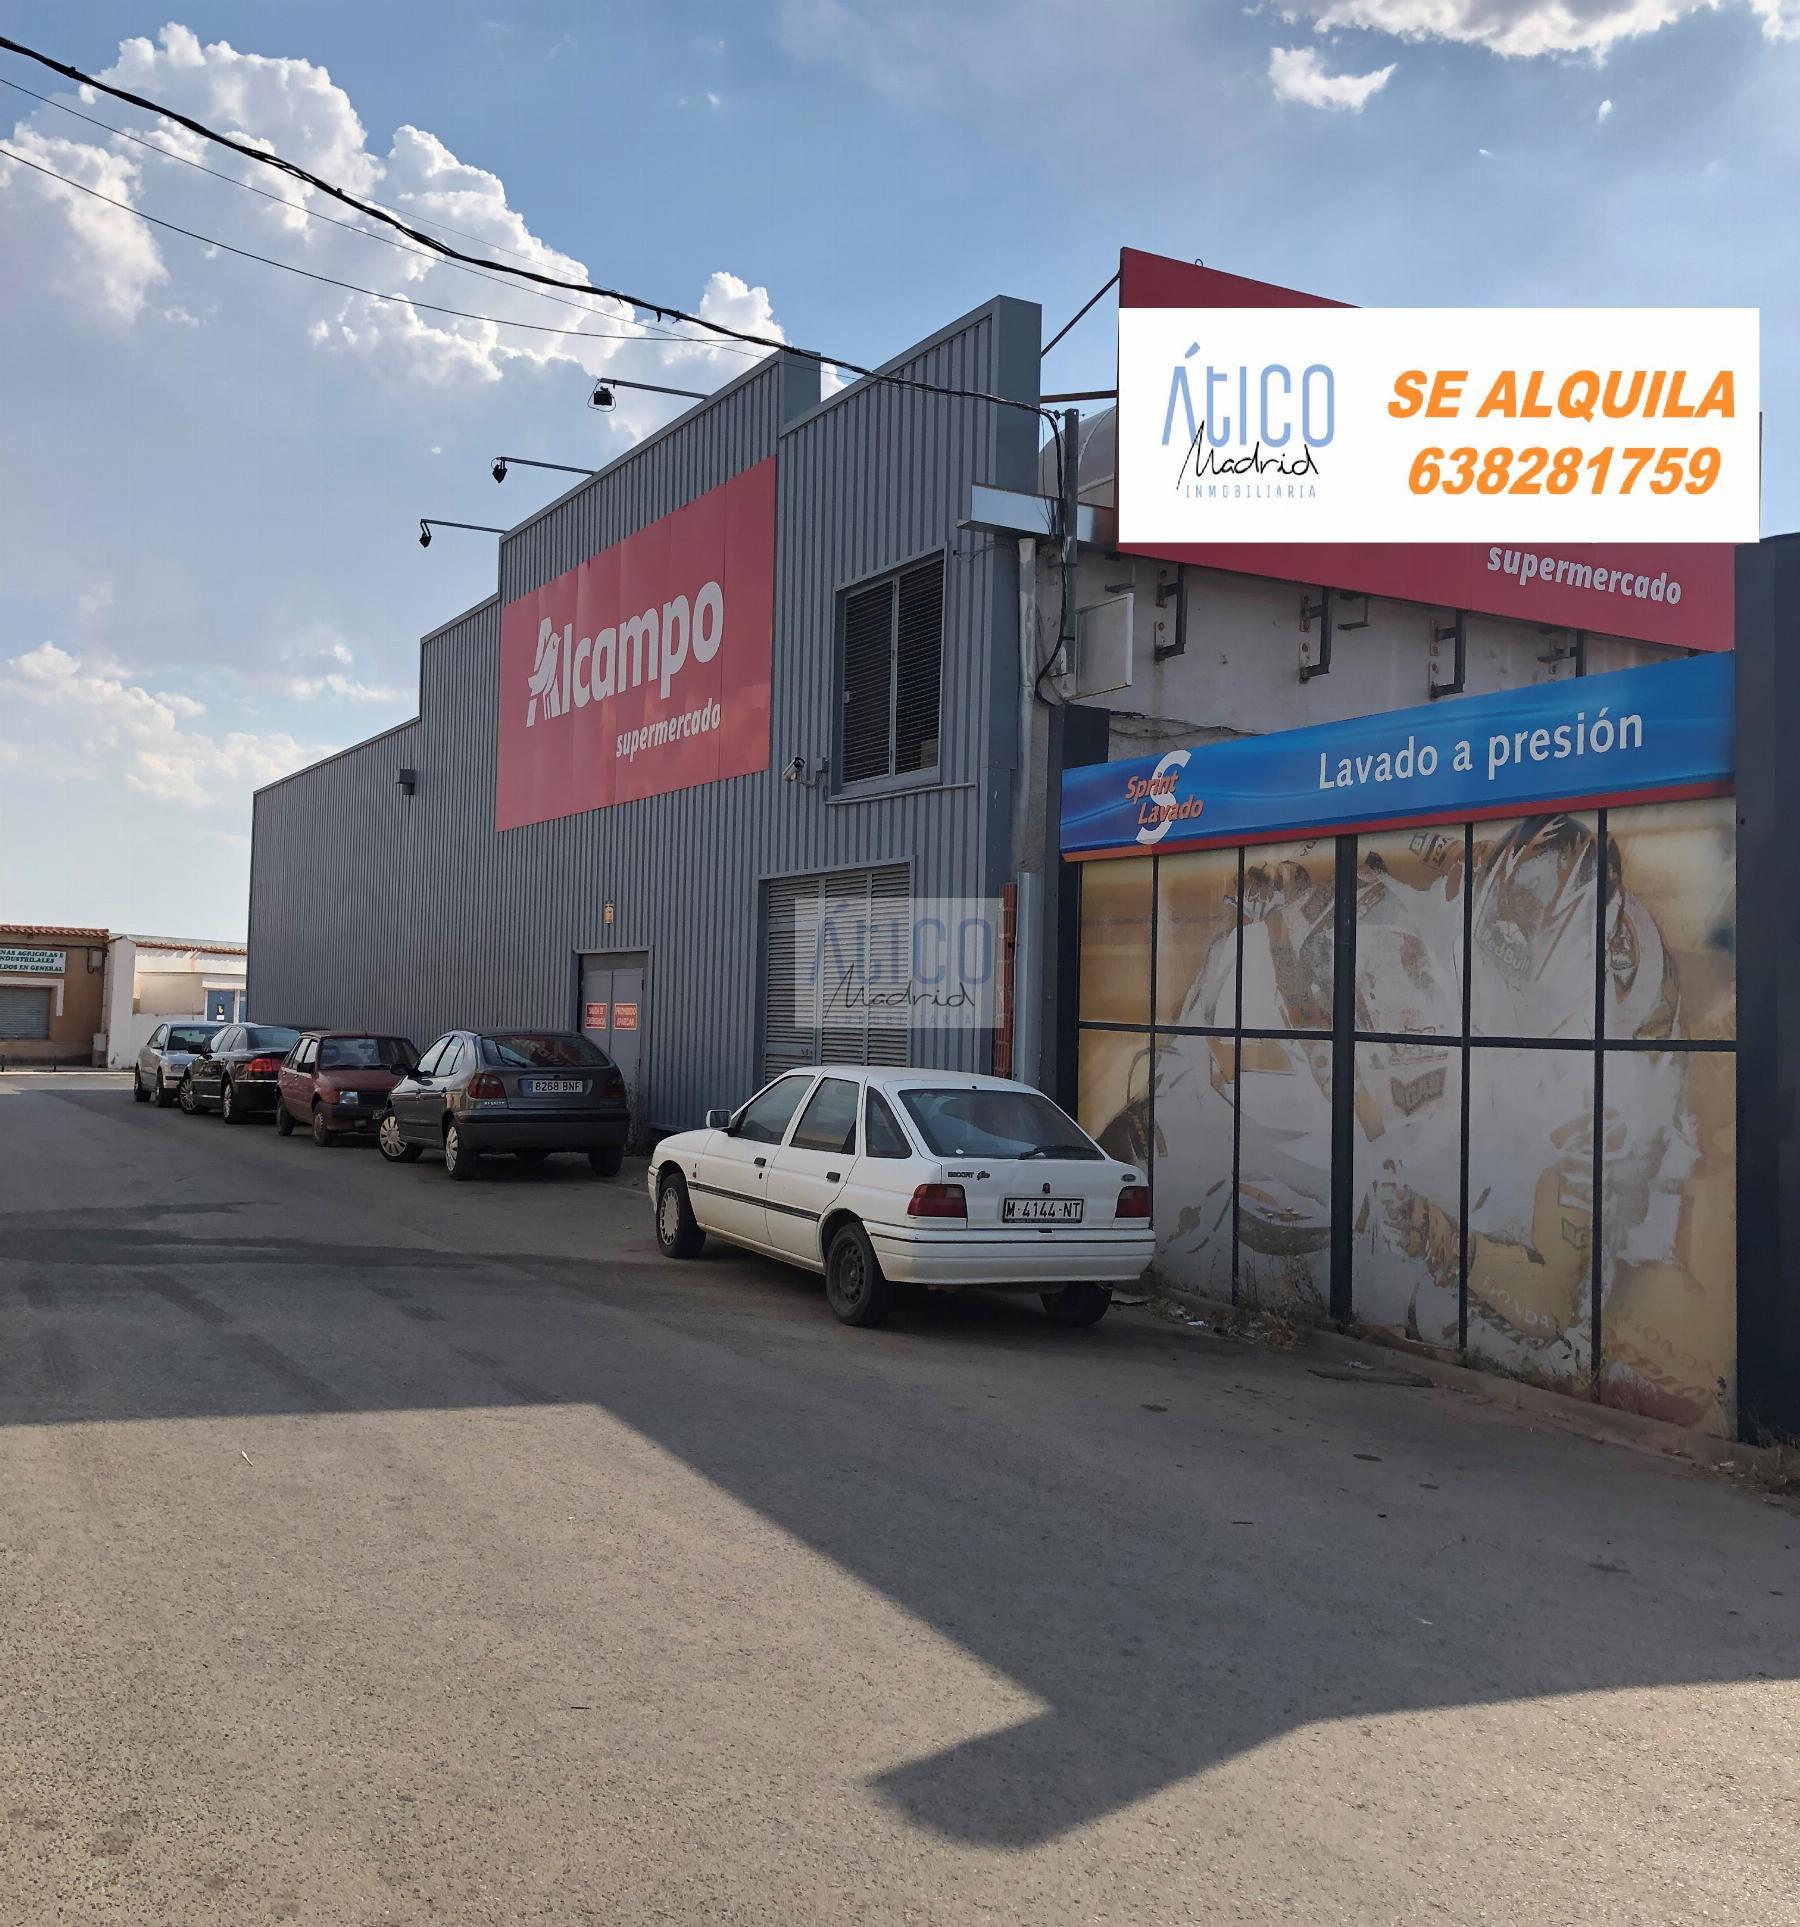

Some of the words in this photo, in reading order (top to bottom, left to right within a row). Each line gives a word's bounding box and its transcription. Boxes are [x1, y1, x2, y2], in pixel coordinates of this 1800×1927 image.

[1487, 546, 1682, 605] supermercado
[526, 581, 725, 728] Alcampo
[616, 698, 722, 763] supermercado
[1319, 735, 1439, 790] Lavado
[1452, 739, 1473, 773] a
[1487, 707, 1643, 781] presión
[1124, 770, 1180, 805] Sprint
[1137, 793, 1204, 825] Lavado
[535, 1081, 559, 1092] 8268
[562, 1081, 581, 1092] BNF
